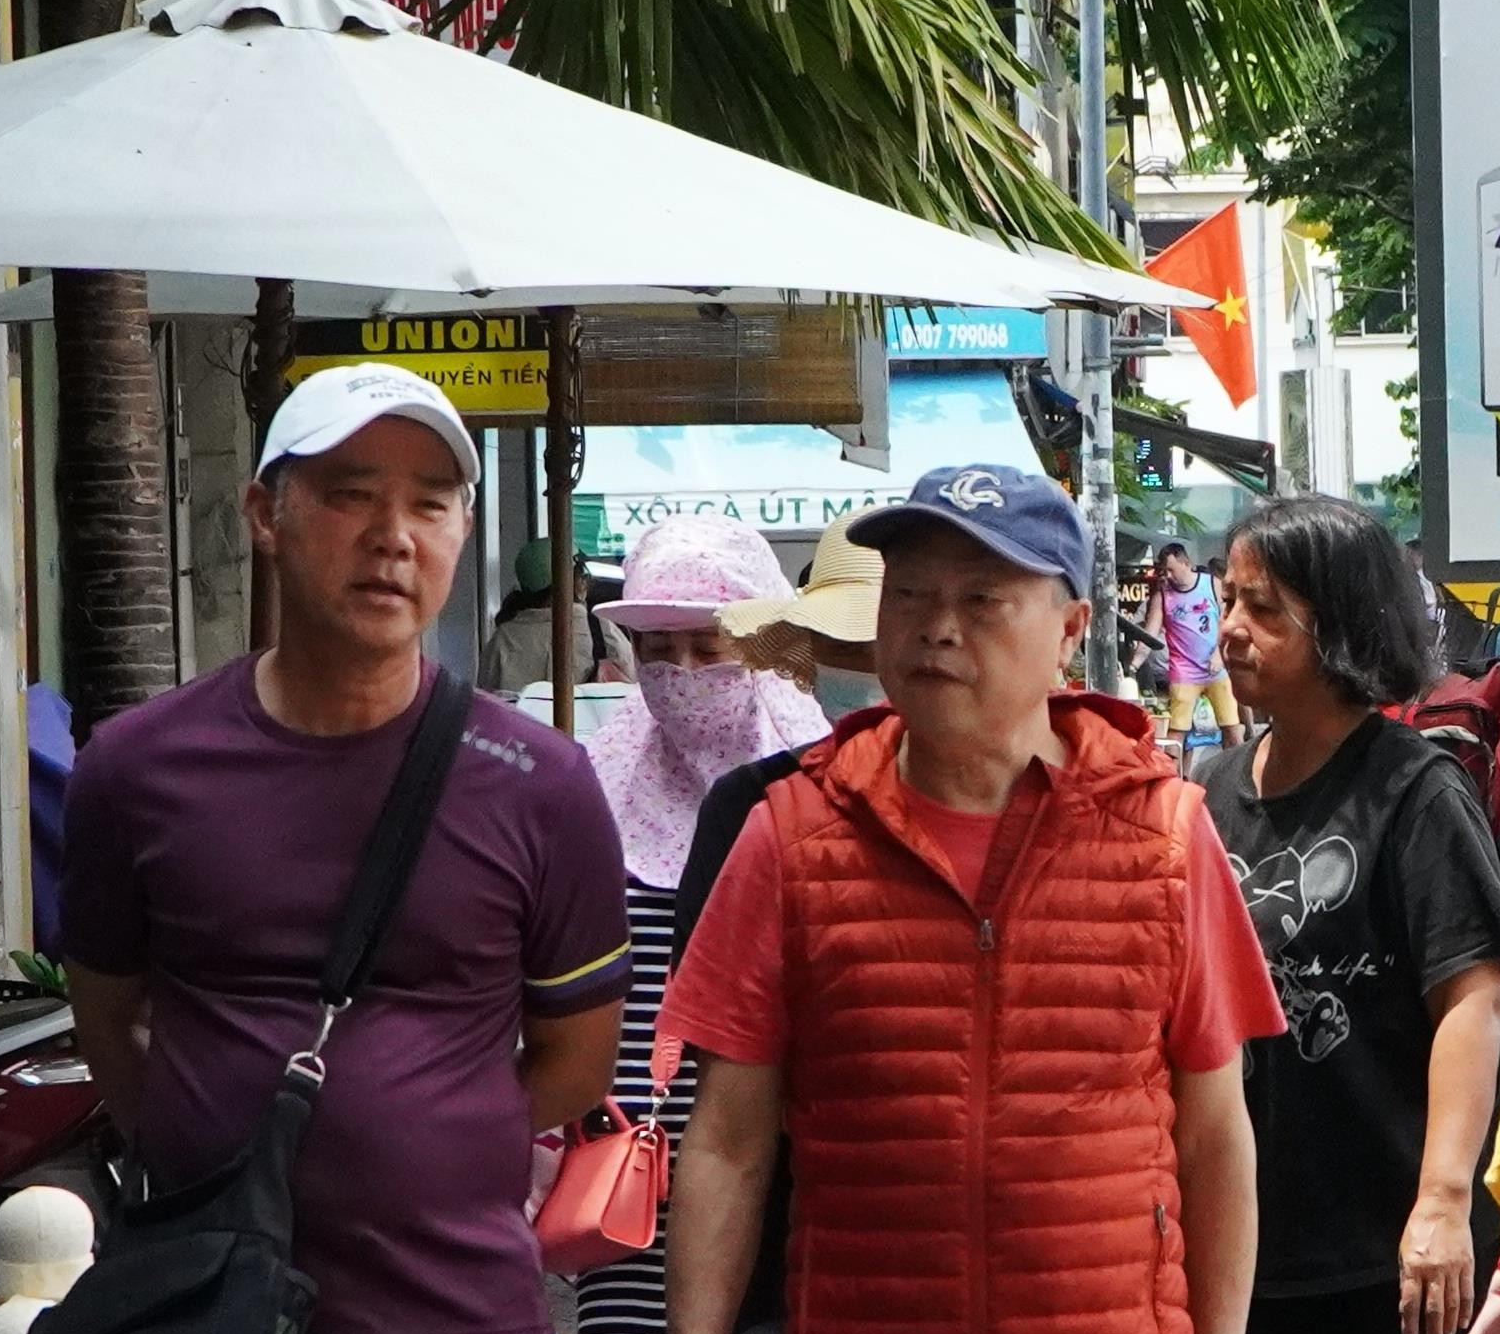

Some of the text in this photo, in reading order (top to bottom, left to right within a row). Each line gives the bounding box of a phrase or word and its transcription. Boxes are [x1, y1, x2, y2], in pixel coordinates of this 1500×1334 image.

[361, 320, 515, 351] UNION
[948, 322, 1008, 349] 799068
[759, 489, 809, 524] ÚT
